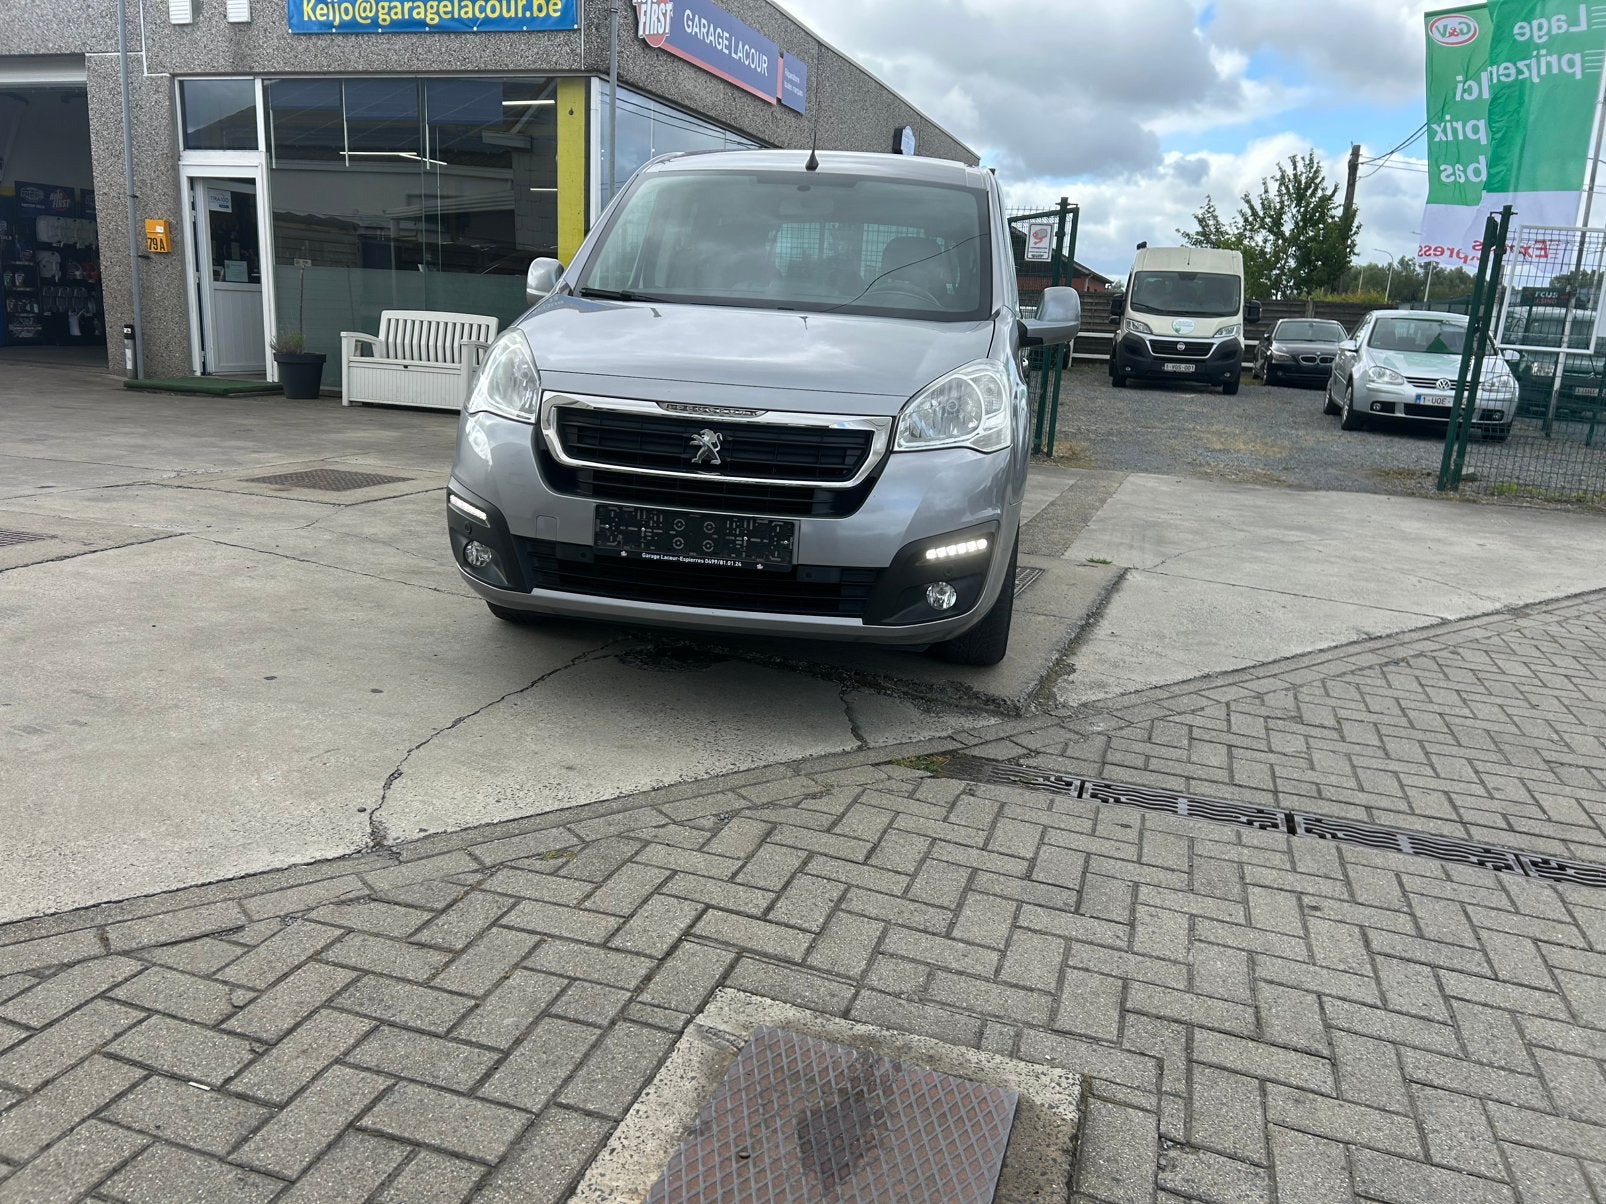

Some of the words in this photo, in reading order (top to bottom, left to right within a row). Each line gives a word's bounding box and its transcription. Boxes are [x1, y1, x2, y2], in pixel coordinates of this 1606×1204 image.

[302, 0, 562, 26] Keijo@garagelacour.be
[638, 2, 673, 36] FIRST
[683, 9, 730, 54] GARAGE
[731, 36, 768, 77] LACOUR
[641, 552, 660, 560] Garage
